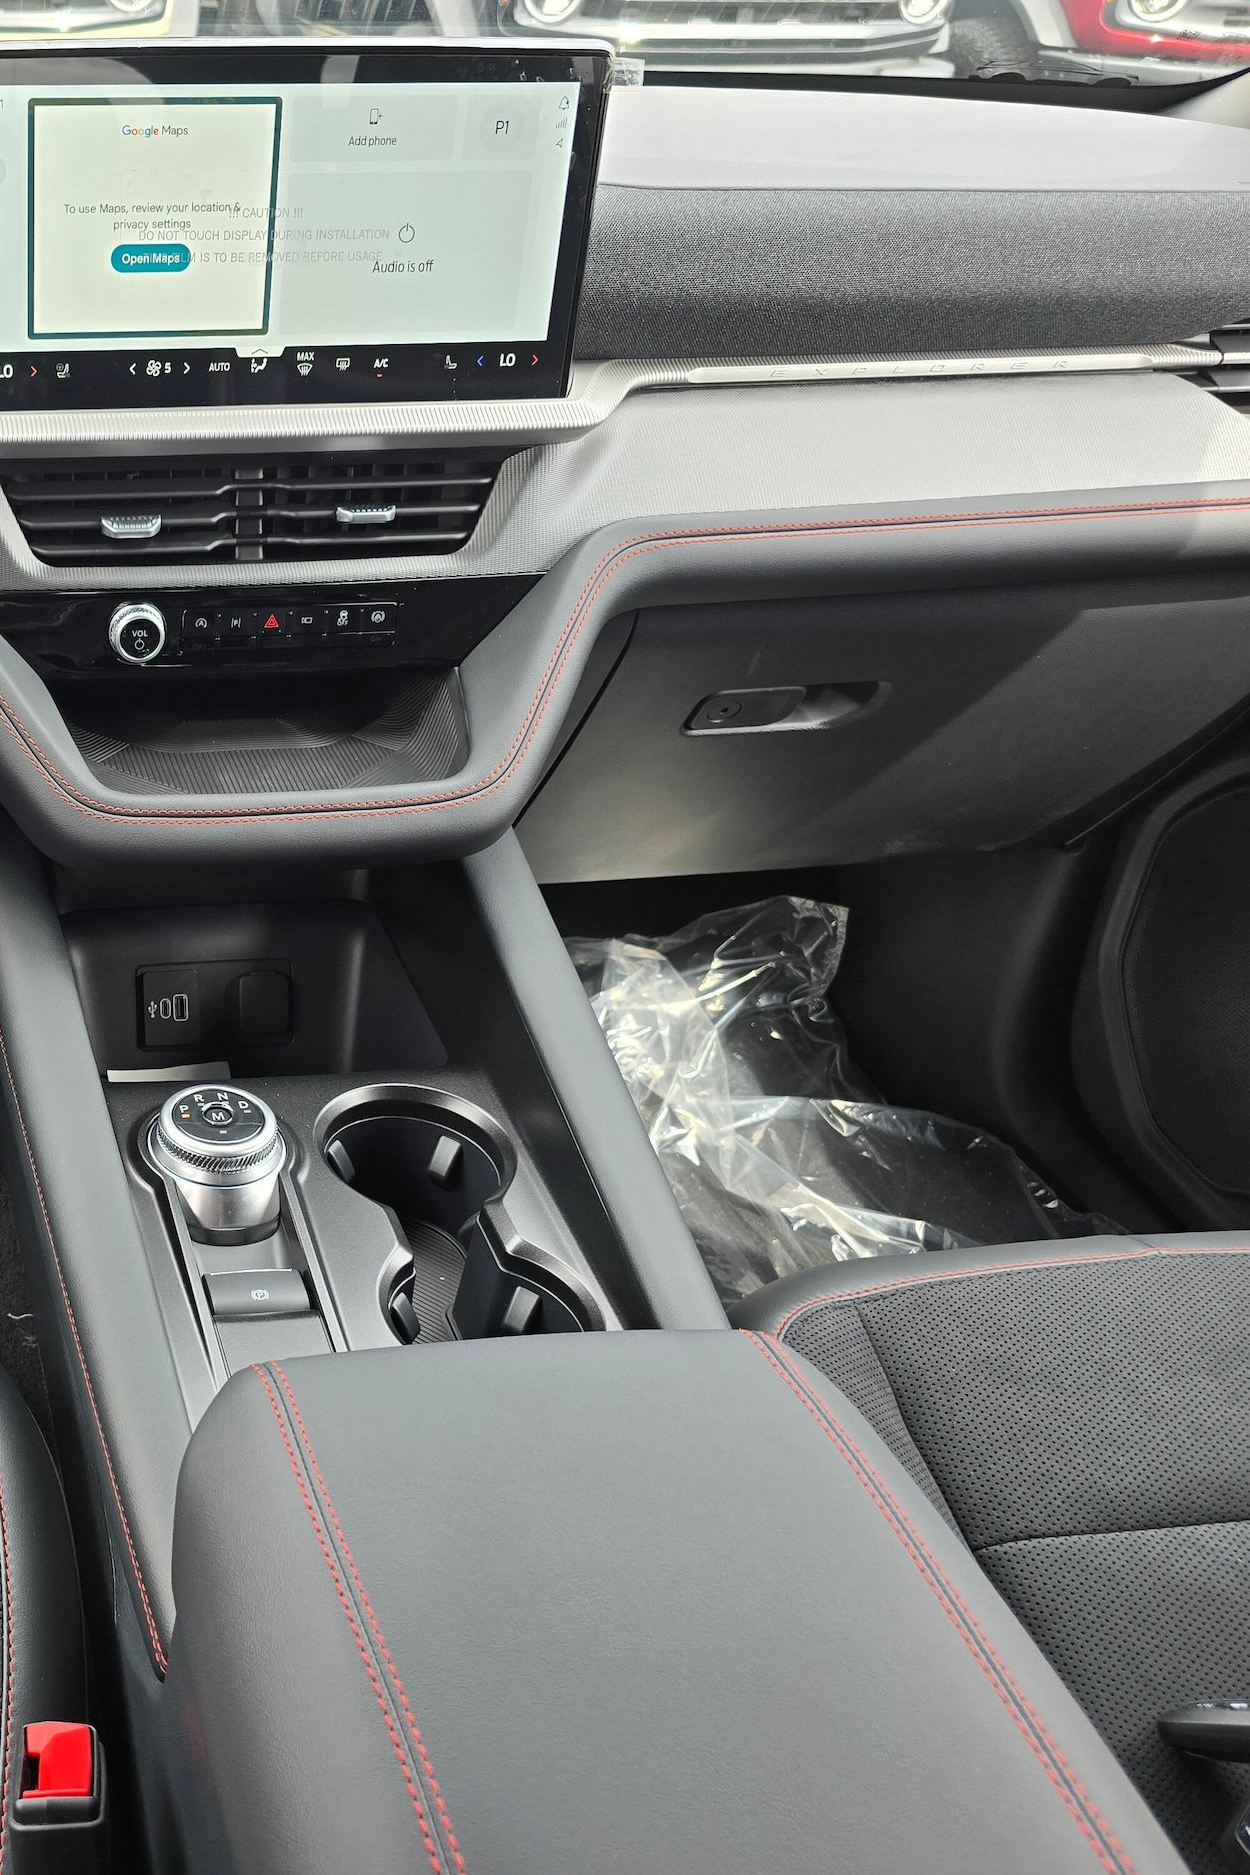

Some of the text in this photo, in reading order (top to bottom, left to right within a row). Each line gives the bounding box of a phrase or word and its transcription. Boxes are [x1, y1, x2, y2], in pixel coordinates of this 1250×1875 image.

[121, 124, 188, 138] Google Maps
[495, 121, 510, 135] P1
[348, 135, 397, 149] Add phone
[64, 202, 242, 216] To use Maps, review your location &
[242, 207, 290, 218] CAUTION
[113, 219, 191, 231] privacy settings
[138, 229, 390, 241] DO NOT TOUCH DISPLAY DURING INSTALLATION
[122, 253, 150, 267] Open
[152, 252, 180, 266] Maps
[200, 253, 210, 263] IS
[214, 253, 228, 263] TO
[230, 252, 246, 263] BE
[248, 252, 300, 263] REMOVED
[303, 251, 344, 262] BEFORE
[347, 251, 383, 262] USAGE
[372, 259, 434, 273] Audio is off
[297, 352, 315, 361] MAX
[500, 353, 516, 367] LO
[164, 362, 172, 373] 5
[208, 362, 231, 372] AUTO
[374, 358, 389, 368] A/C
[769, 360, 1068, 377] EXPLORER
[337, 618, 349, 626] OFF
[131, 630, 149, 638] VOL
[195, 1094, 204, 1103] R
[217, 1092, 229, 1101] N
[179, 1104, 189, 1114] P
[238, 1101, 248, 1111] D
[211, 1112, 225, 1121] M
